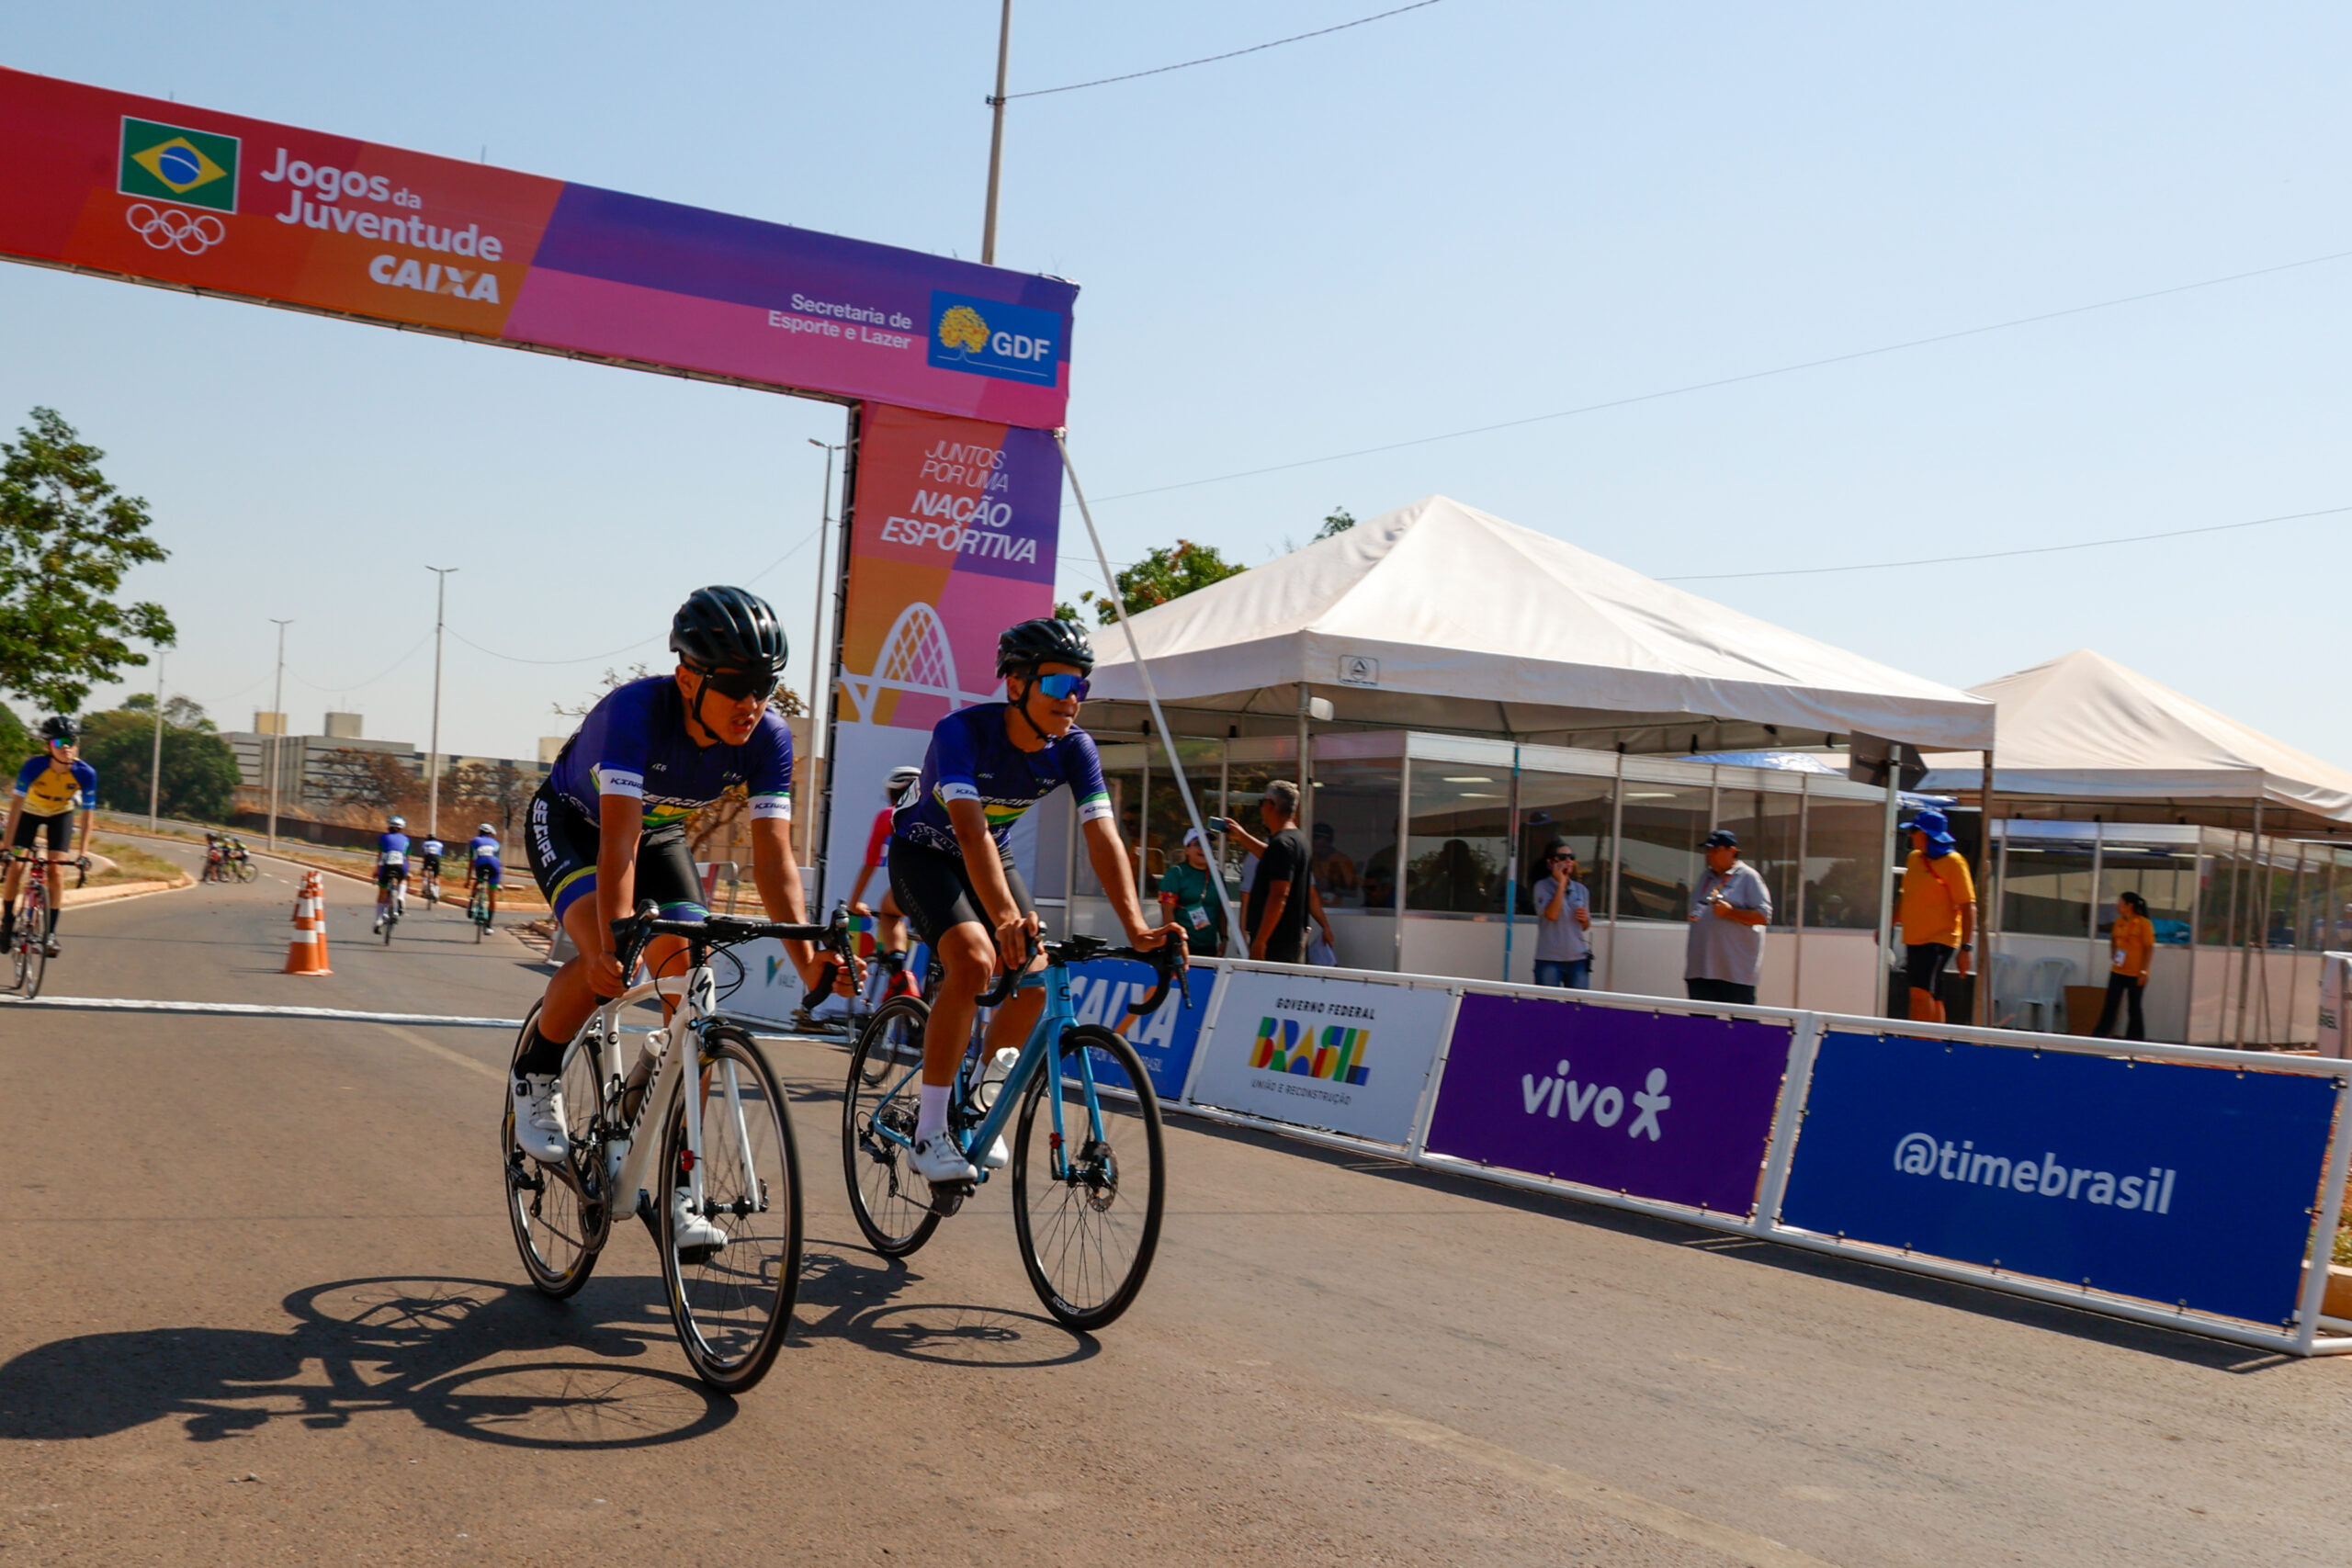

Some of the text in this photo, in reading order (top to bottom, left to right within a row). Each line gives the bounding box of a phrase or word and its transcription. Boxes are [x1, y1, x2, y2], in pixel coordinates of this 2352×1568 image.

[260, 147, 422, 209] Jogos da
[276, 189, 503, 261] Juventude
[369, 254, 500, 304] CAIXA
[768, 310, 912, 350] Esporte e Lazer
[790, 293, 912, 331] Secretaria de
[991, 332, 1051, 362] GDF
[924, 440, 1007, 470] JUNTOS
[920, 460, 1009, 493] POR UMA
[910, 490, 1012, 528] NAÇÃO
[880, 516, 1037, 564] ESPORTIVA
[1275, 998, 1376, 1021] GOVERNO FEDERAL
[1248, 1016, 1371, 1087] BRASIL
[1251, 1078, 1352, 1106] UNIÃO E RECONSTRUÇÃO
[1521, 1059, 1624, 1128] vivo
[1894, 1132, 2177, 1215] @timebrasil
